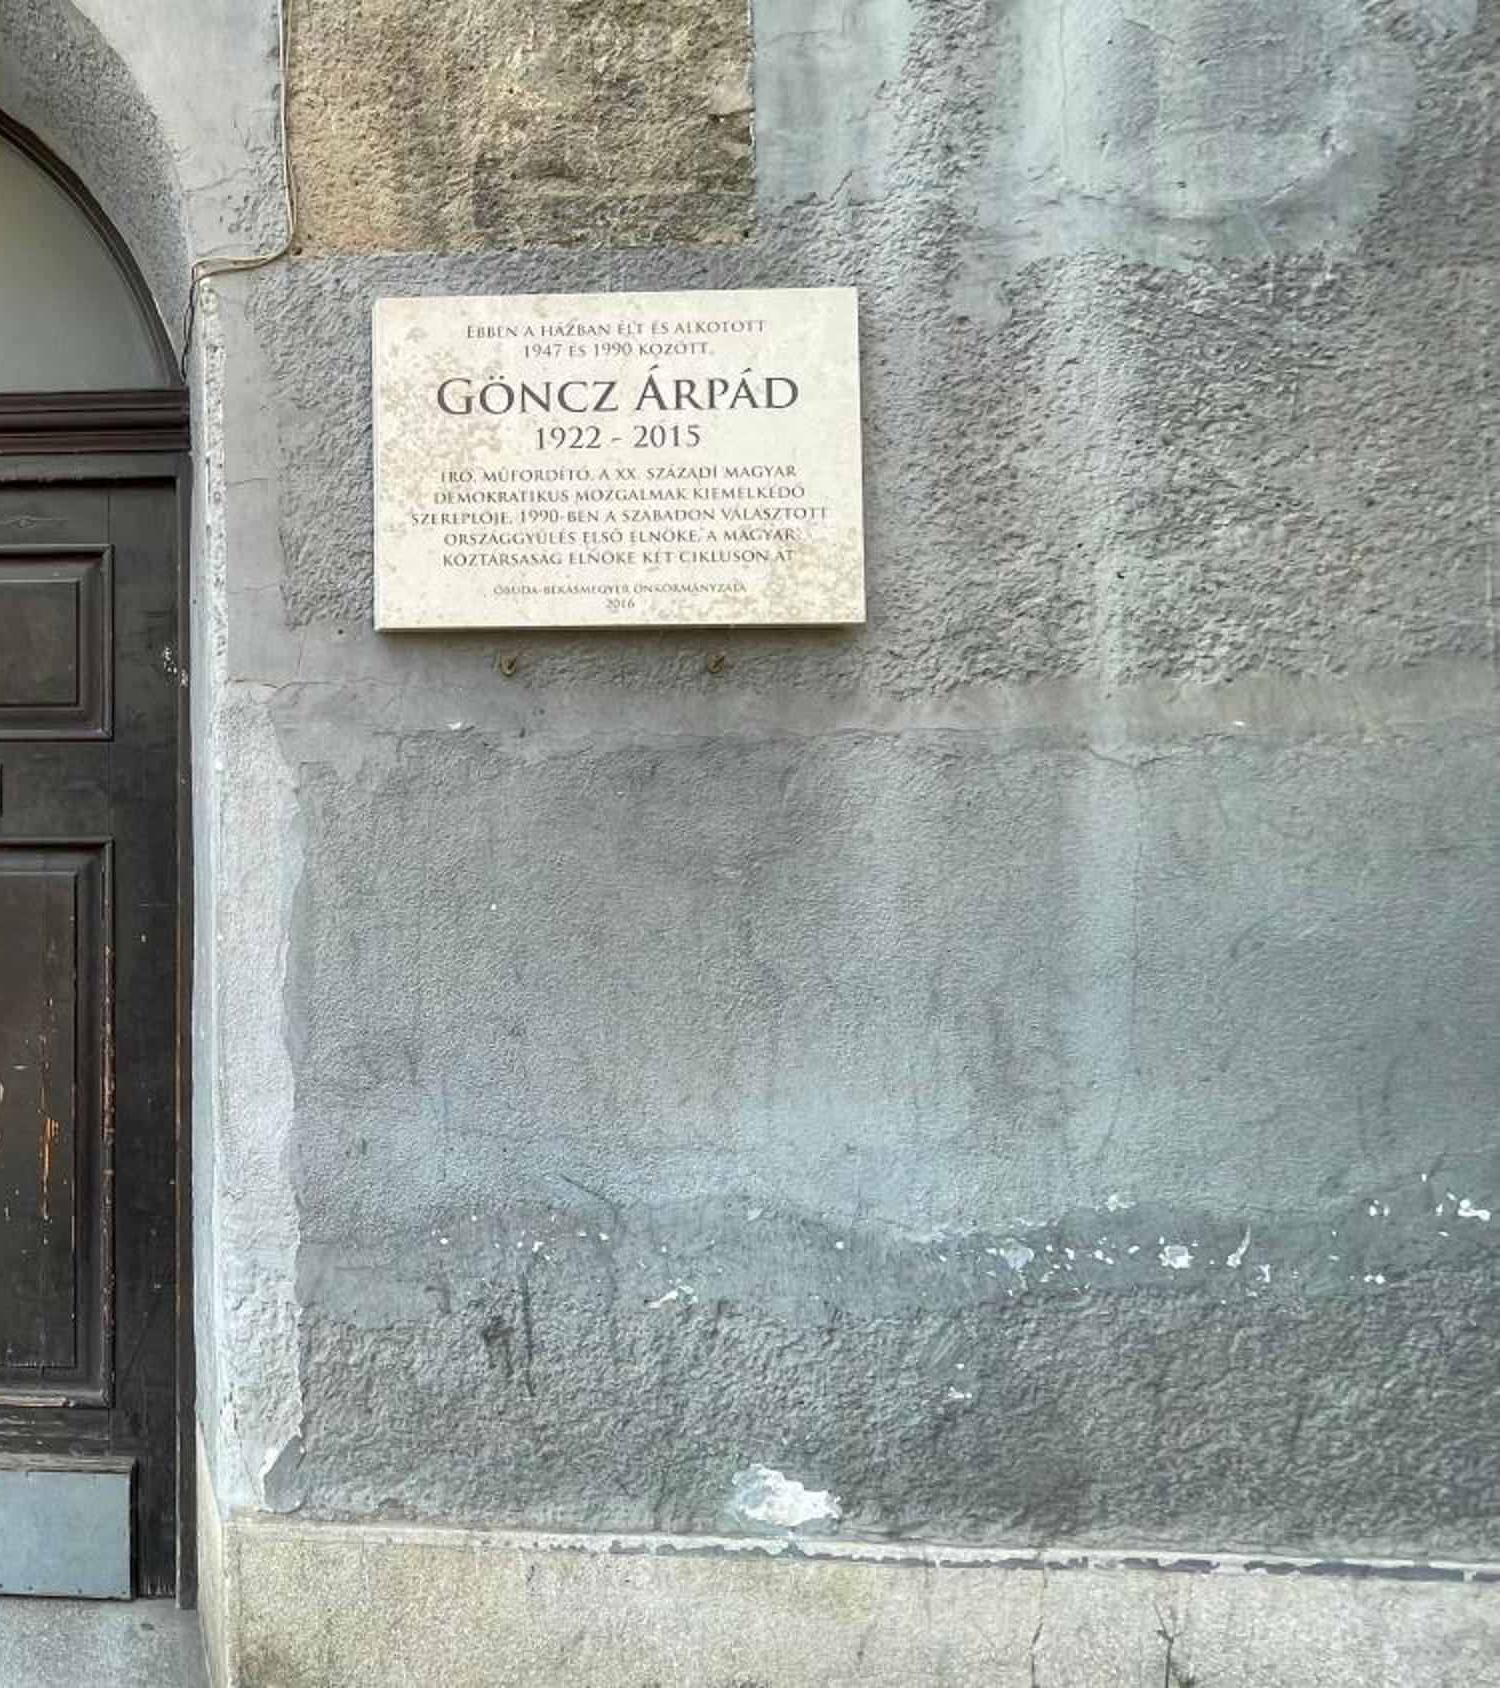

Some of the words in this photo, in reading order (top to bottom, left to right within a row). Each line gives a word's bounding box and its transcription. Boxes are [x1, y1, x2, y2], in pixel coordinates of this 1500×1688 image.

[467, 325, 518, 339] EBBEN
[523, 325, 535, 337] A
[673, 320, 766, 334] ALKOTOTT
[524, 343, 563, 359] 1947
[594, 342, 633, 357] 1990
[437, 375, 619, 414] GÖNCZ
[635, 365, 799, 410] ÁRPÁD
[535, 426, 601, 450] 1922
[633, 424, 701, 448] 2015
[599, 469, 611, 481] A
[725, 465, 797, 479] MAGYAR
[434, 489, 569, 504] DEMOKRATIKUS
[575, 488, 687, 502] MOZGALMAK
[520, 508, 599, 523] 1990-BEN
[605, 510, 616, 522] A
[622, 508, 715, 522] SZABADON
[706, 530, 717, 542] A
[724, 528, 798, 541] MAGYAR
[679, 549, 769, 563] CIKLUSON
[605, 598, 635, 609] 2016
